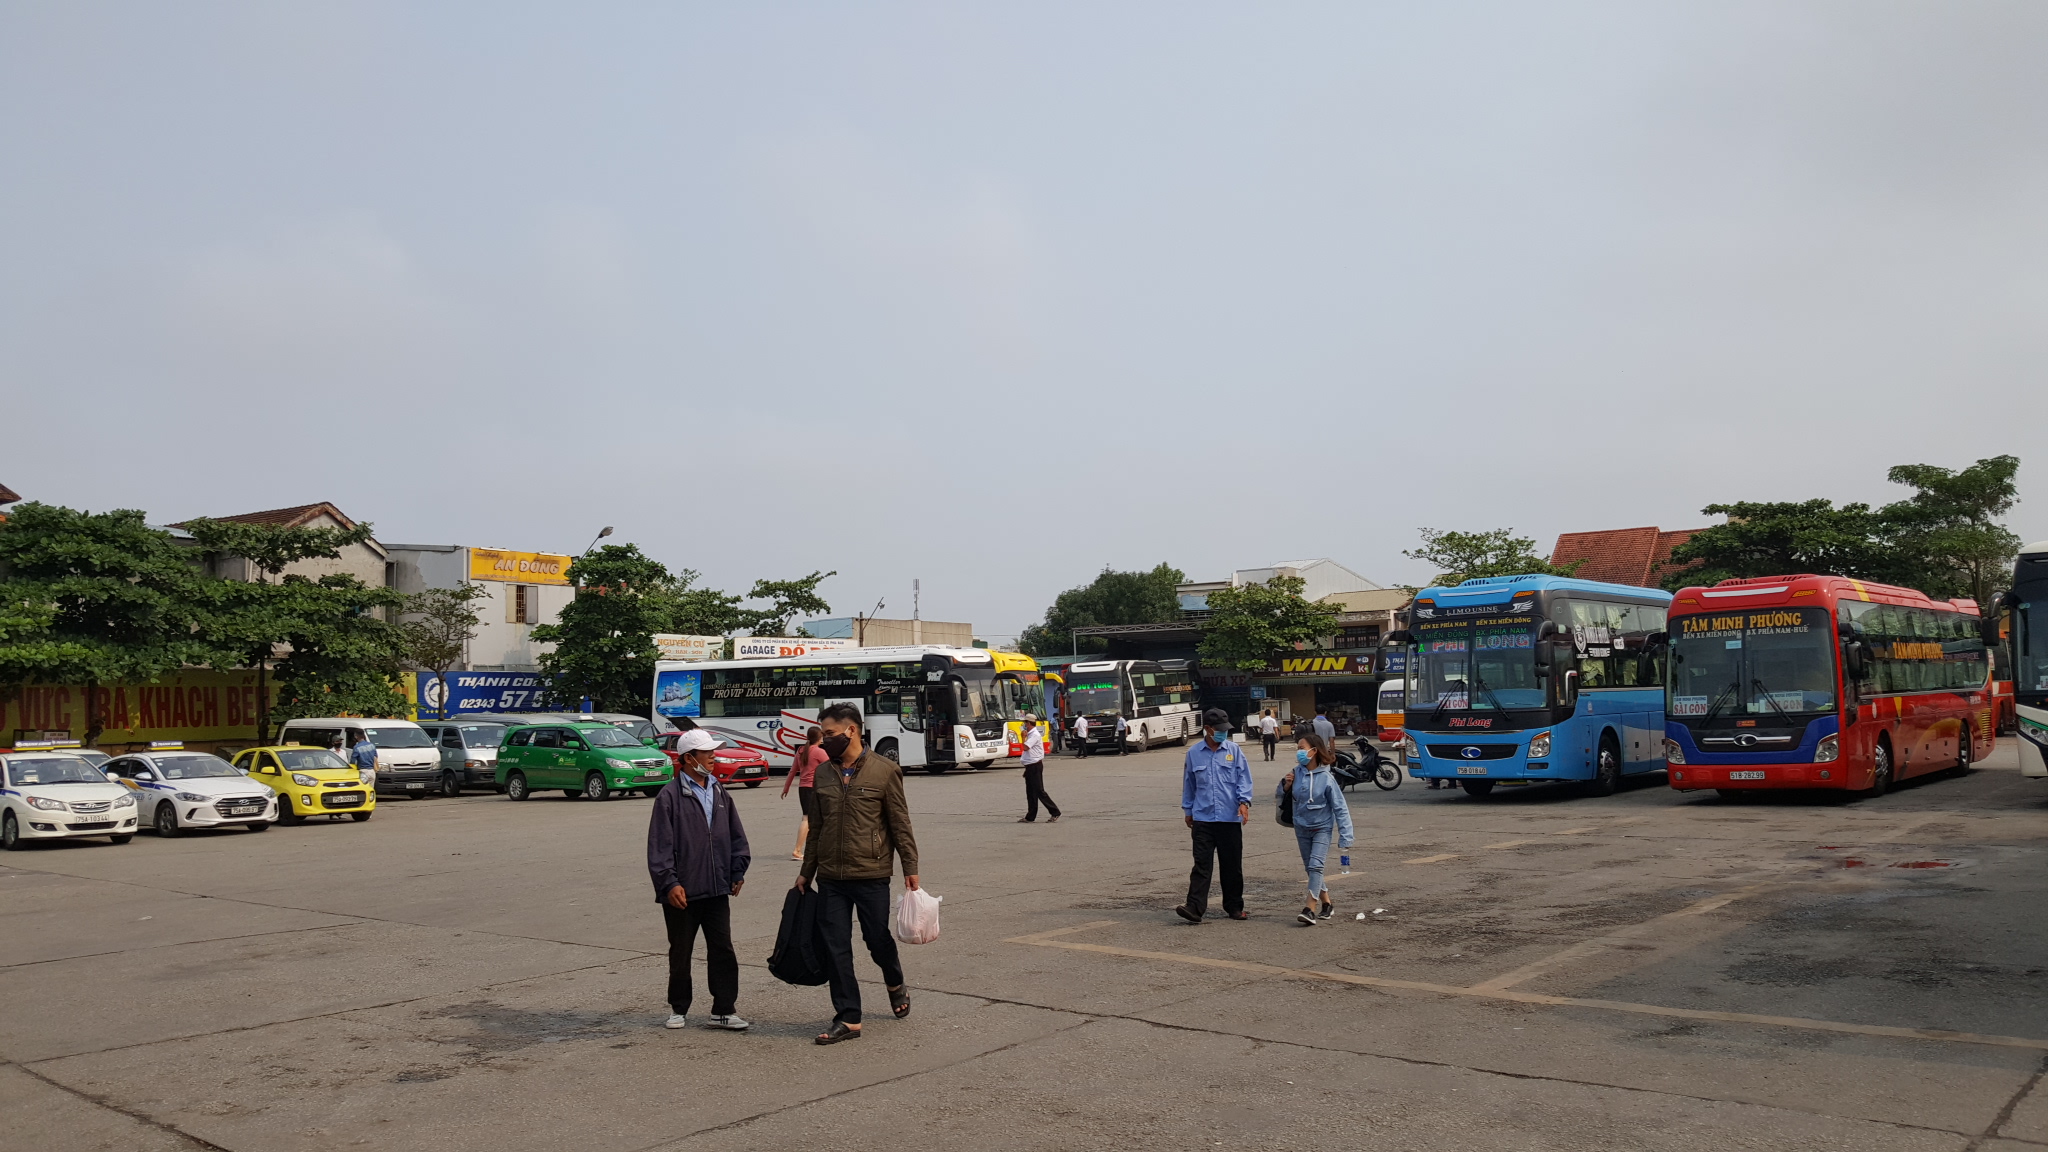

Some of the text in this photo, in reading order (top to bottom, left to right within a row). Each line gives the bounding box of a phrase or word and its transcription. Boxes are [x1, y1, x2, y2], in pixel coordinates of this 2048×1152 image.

[1446, 606, 1499, 614] LIMOUSINE
[1682, 610, 1802, 632] TÂM MINH PHƯƠNG
[1432, 634, 1530, 651] PHI LONG
[740, 645, 776, 655] GARAGE
[1282, 656, 1348, 672] WIN
[746, 688, 773, 697] DAISY
[773, 687, 797, 696] OPEN
[799, 686, 818, 696] BUS
[138, 677, 219, 728] KHÁCH
[459, 698, 496, 708] 02343
[499, 690, 529, 708] 57
[1674, 701, 1706, 714] SÀI GÒN
[1448, 717, 1492, 728] Phi Long
